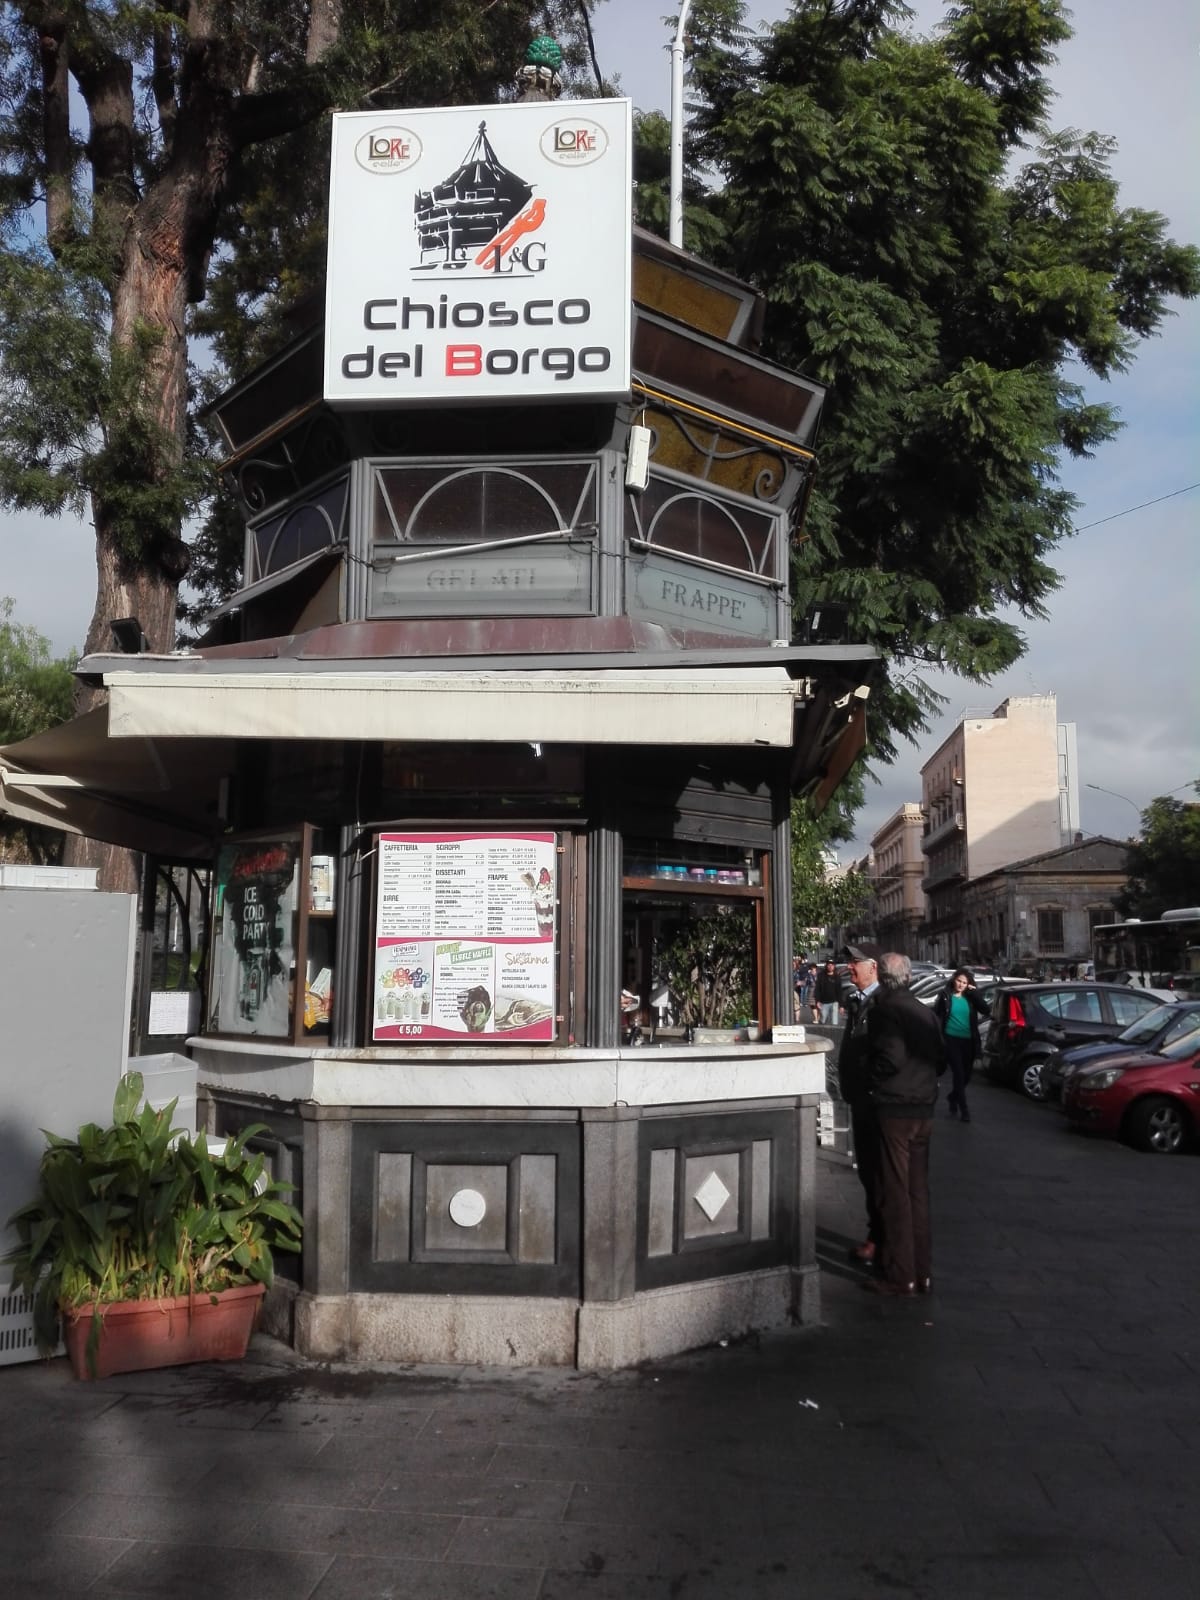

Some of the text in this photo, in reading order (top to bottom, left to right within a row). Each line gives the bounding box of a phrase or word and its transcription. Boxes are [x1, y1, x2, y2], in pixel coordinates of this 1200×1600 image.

[492, 241, 547, 274] L&G
[364, 294, 592, 330] Chiosco
[341, 343, 612, 381] del Borgo
[426, 568, 538, 590] GELATI
[243, 886, 257, 903] ICE
[243, 904, 264, 922] COLD
[242, 921, 271, 940] PARTY
[504, 952, 549, 966] Susanna
[406, 1025, 422, 1035] 5,00
